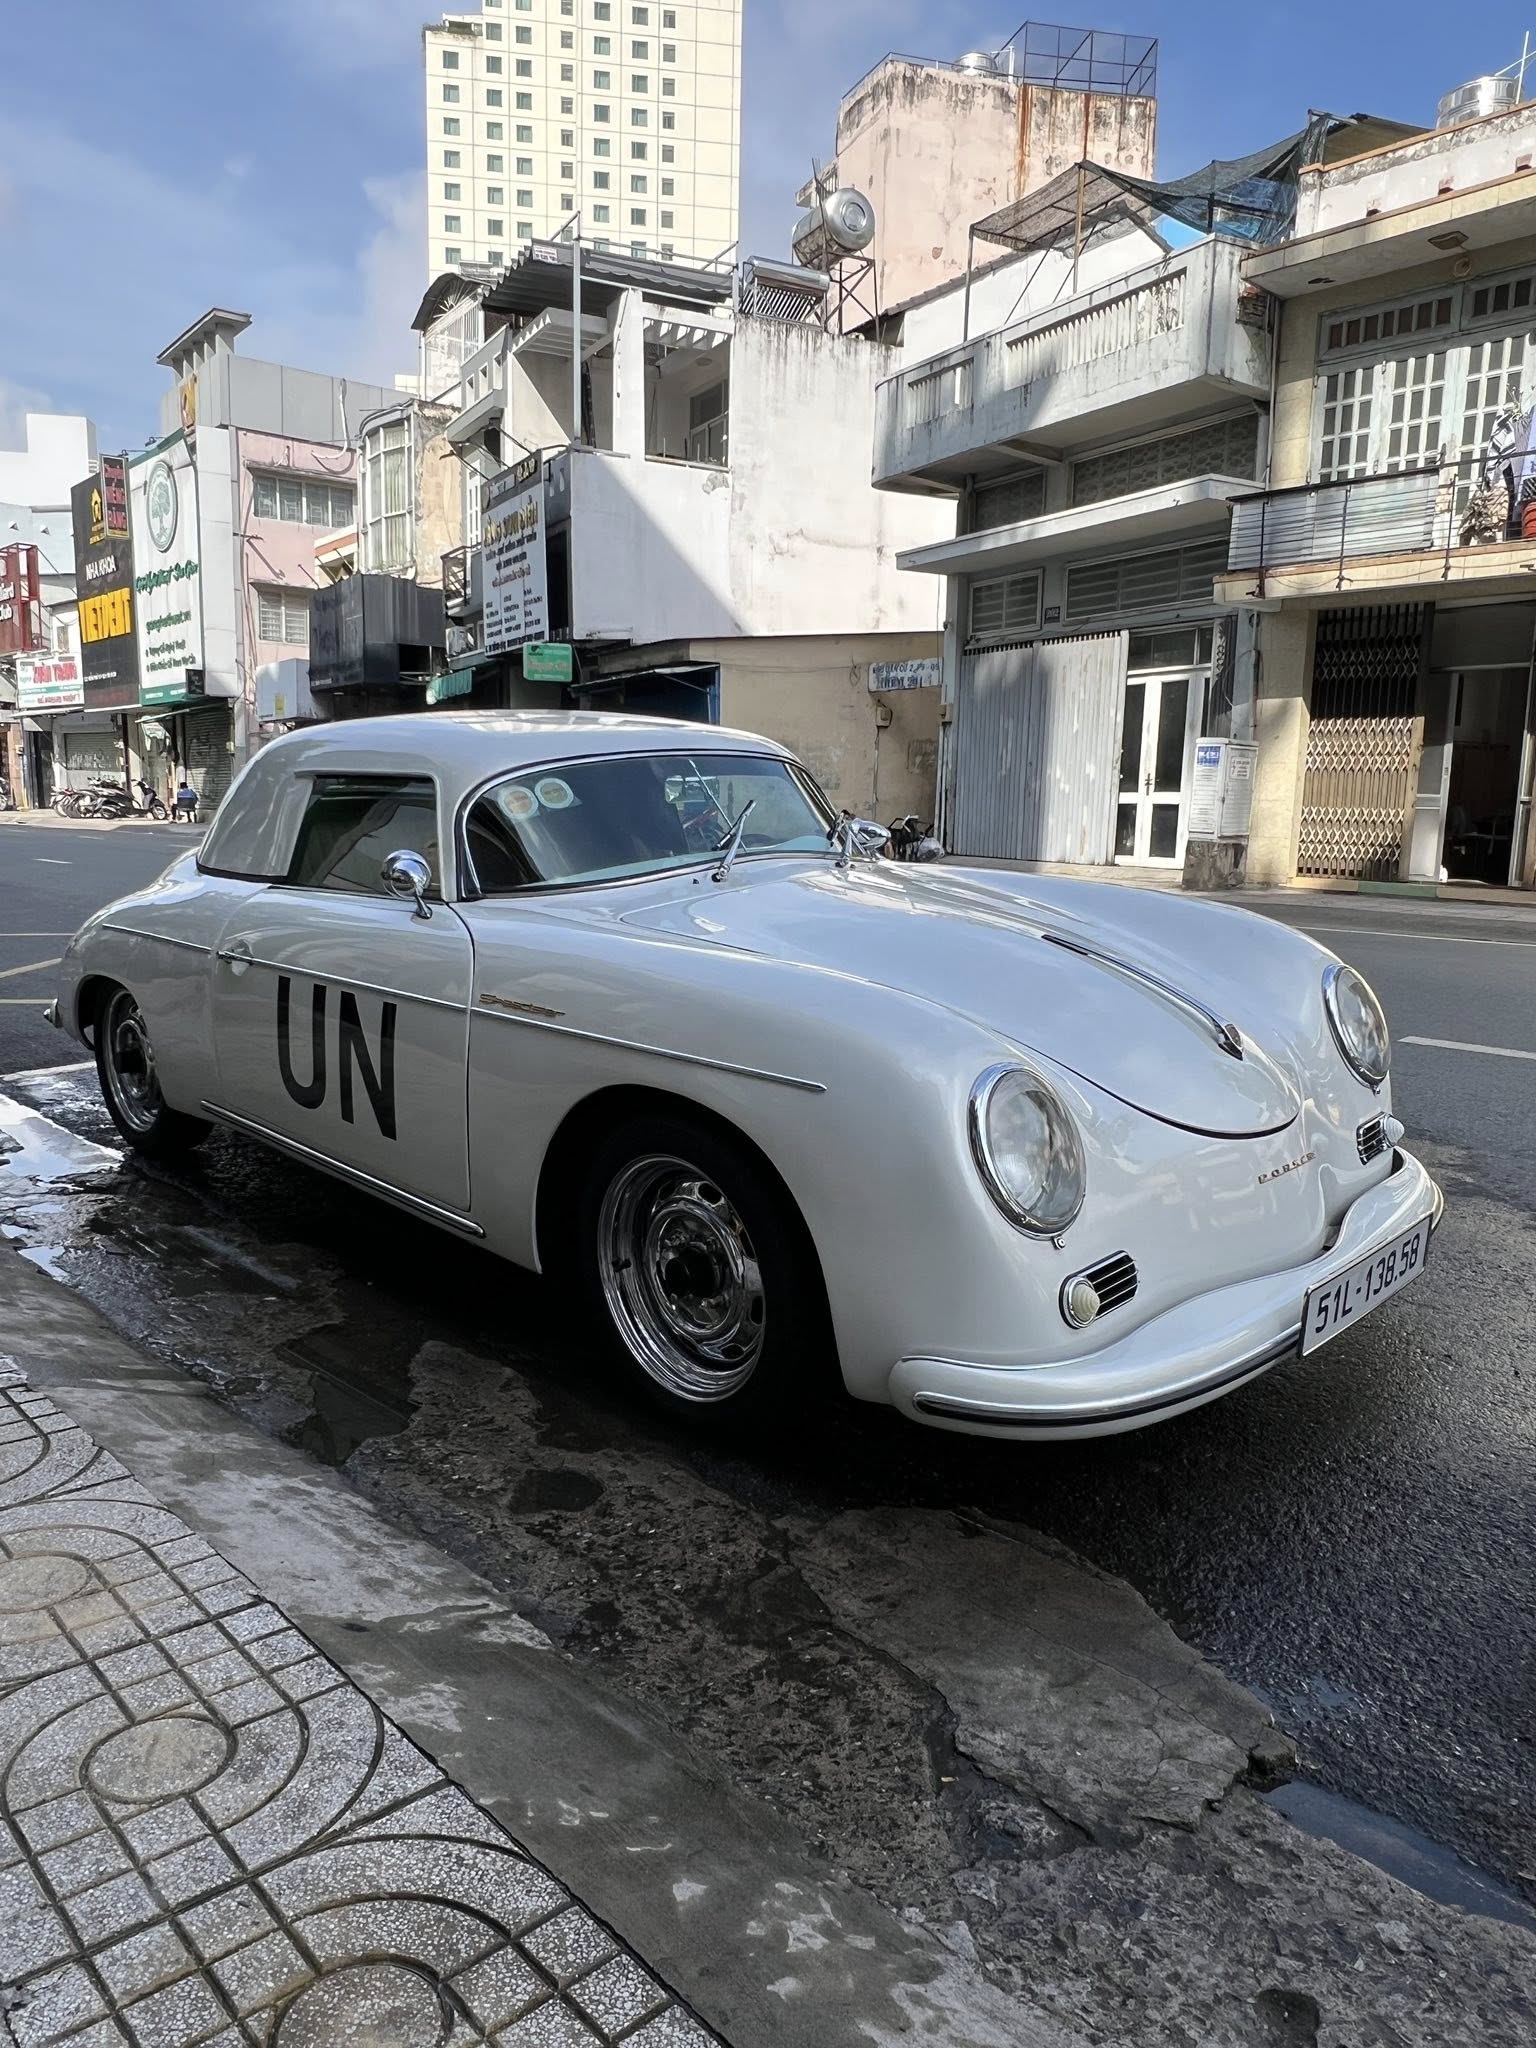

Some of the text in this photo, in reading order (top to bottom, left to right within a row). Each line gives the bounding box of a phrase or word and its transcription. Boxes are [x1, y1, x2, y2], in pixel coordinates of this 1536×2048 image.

[85, 554, 117, 581] NHA KHOA
[277, 975, 397, 1140] UN
[1315, 1233, 1420, 1334] 51L-138.58
